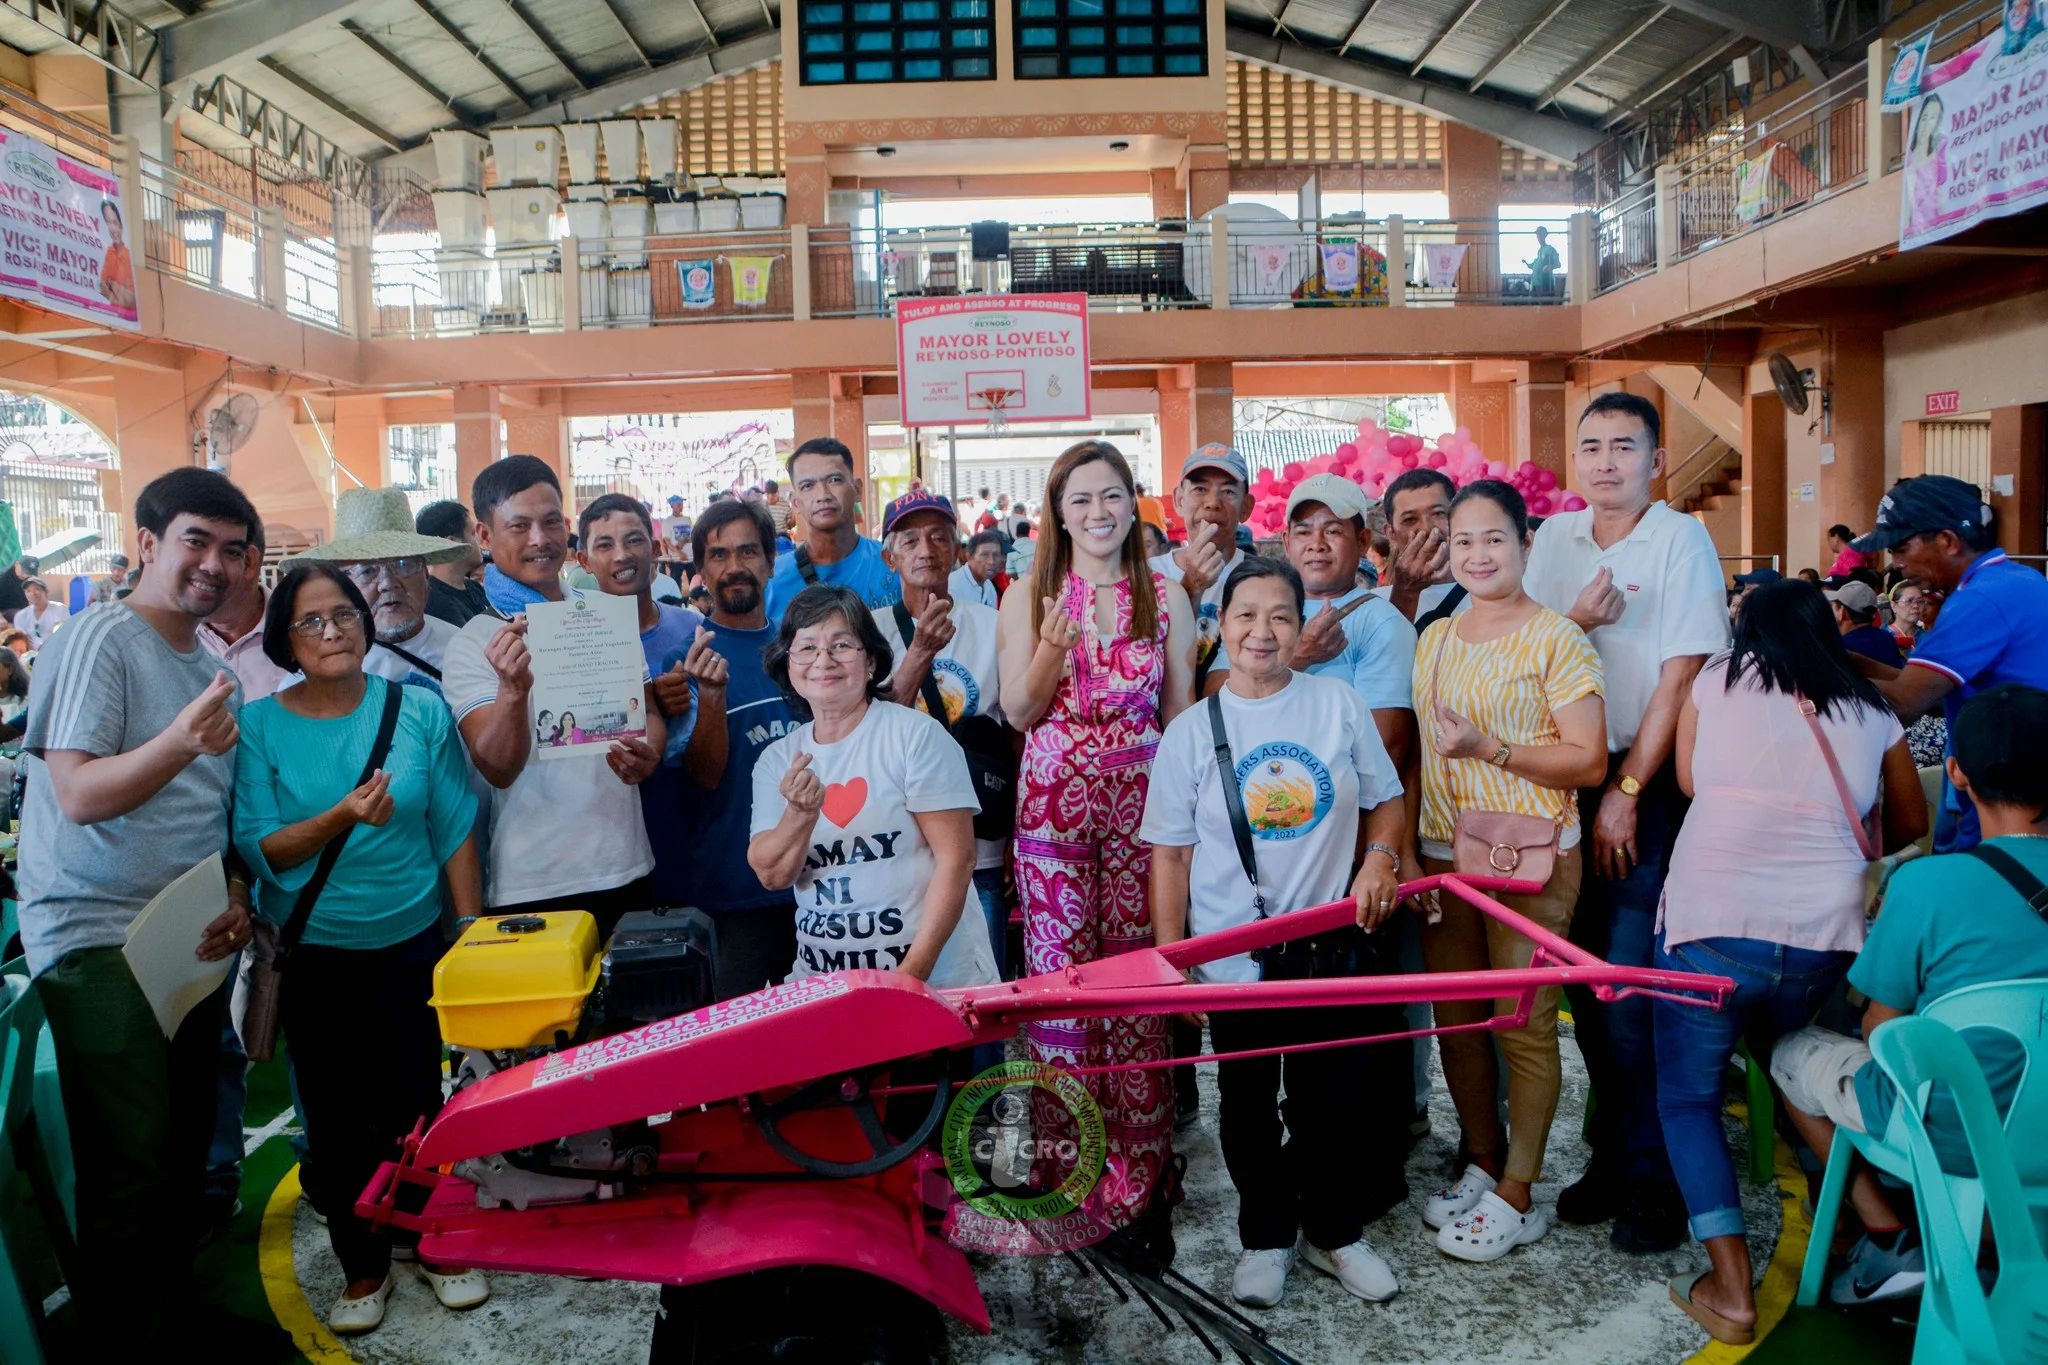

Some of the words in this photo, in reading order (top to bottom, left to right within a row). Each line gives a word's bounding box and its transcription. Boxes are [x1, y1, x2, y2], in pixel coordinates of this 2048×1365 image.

[46, 196, 99, 232] LOVELY
[47, 243, 99, 276] MAYOR
[60, 268, 95, 290] DALIDA
[902, 305, 936, 319] TULOY
[939, 302, 961, 313] ANG
[964, 299, 1005, 310] ASENSO
[1008, 299, 1022, 309] AT
[1024, 299, 1081, 312] PROGRESO
[974, 320, 1012, 328] REYNOSO
[920, 334, 988, 349] MAYOR
[996, 331, 1071, 346] LOVELY
[916, 346, 1076, 362] REYNOSO-PONTIOSO
[930, 386, 949, 394] ART
[1928, 394, 1957, 411] EXIT
[894, 490, 938, 512] FDNY
[554, 632, 585, 640] Certificate
[930, 660, 979, 711] ASSOCIATION
[984, 771, 1006, 792] CAT
[1262, 745, 1332, 804] ASSOCIATION
[1274, 829, 1297, 840] 2022
[802, 830, 902, 873] AMAY
[813, 876, 854, 906] NI
[799, 944, 912, 973] AMILY
[573, 979, 846, 1066] REYNOSO-PONTIOSO
[577, 1012, 698, 1058] MAYOR
[708, 972, 838, 1017] LOVELY
[604, 1049, 639, 1064] ANG
[647, 1027, 713, 1050] ASENSO
[721, 1018, 741, 1029] AT
